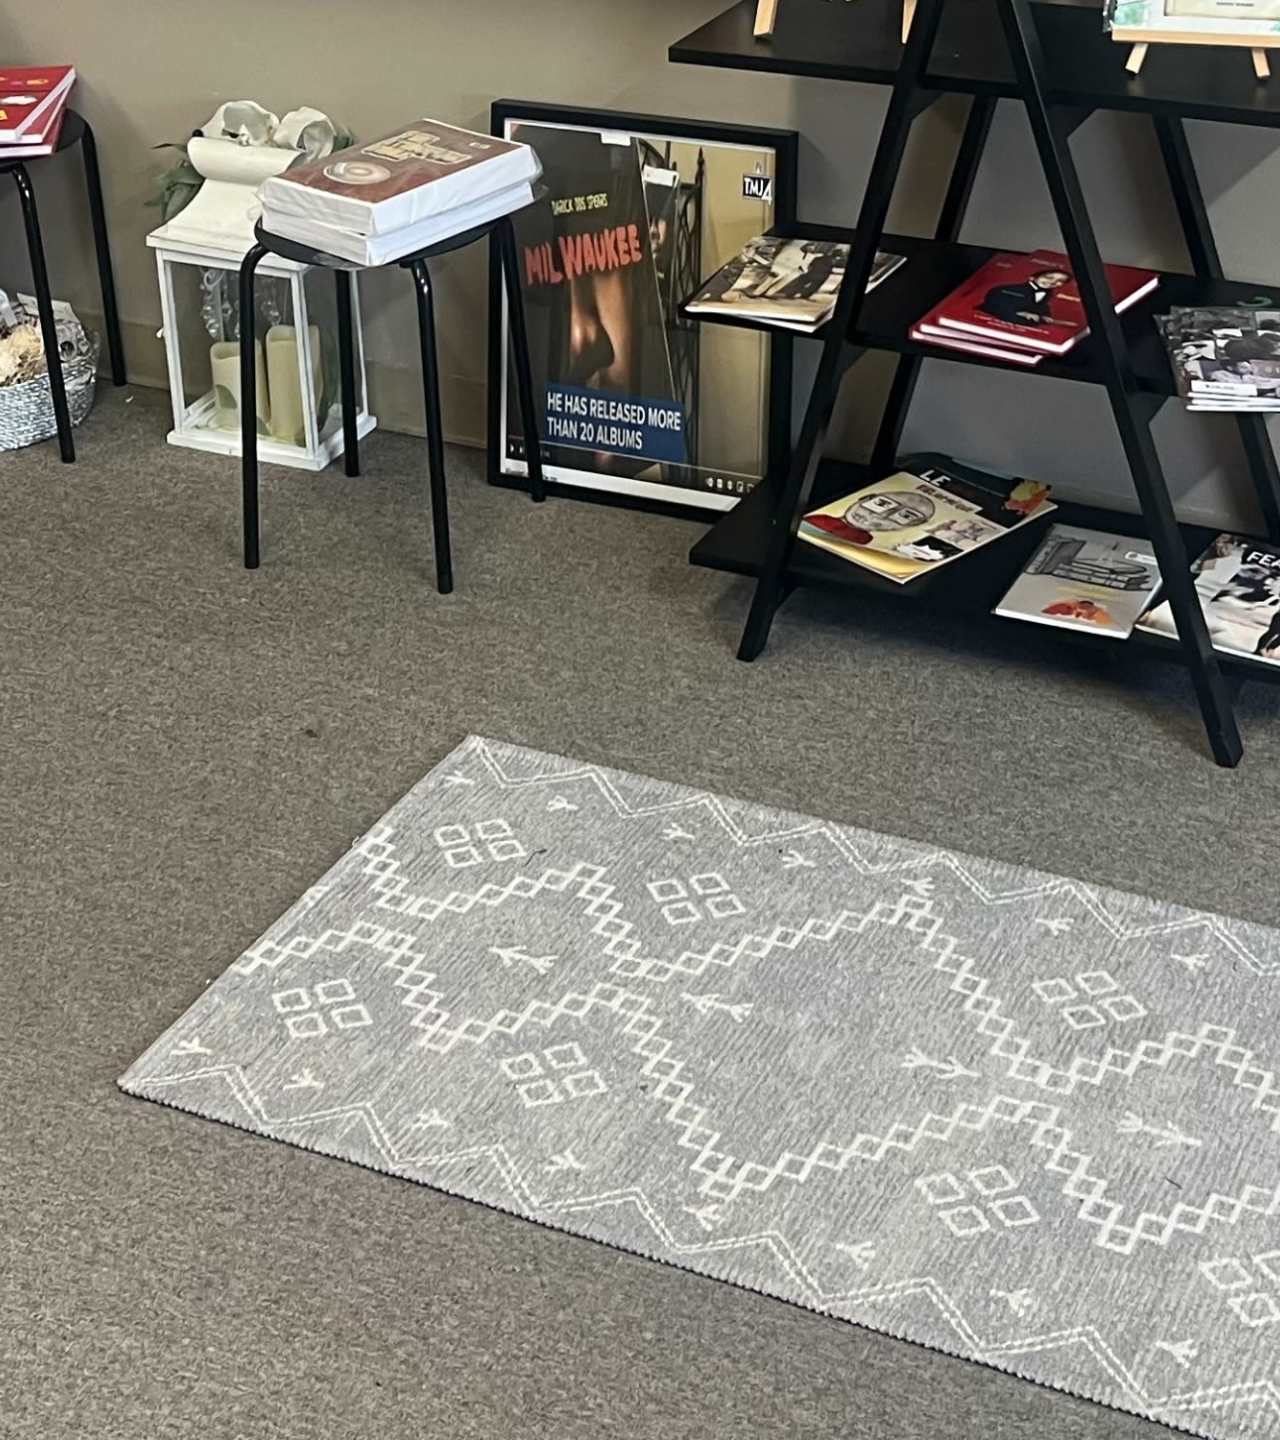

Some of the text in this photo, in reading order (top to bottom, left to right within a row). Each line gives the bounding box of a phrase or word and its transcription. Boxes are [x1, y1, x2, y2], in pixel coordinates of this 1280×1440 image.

[743, 176, 773, 205] TMJ4
[523, 223, 643, 286] MILWAUKEE
[547, 391, 681, 431] HE HAS RELEASED MORE
[547, 416, 643, 450] THAN 20 ALBUMS
